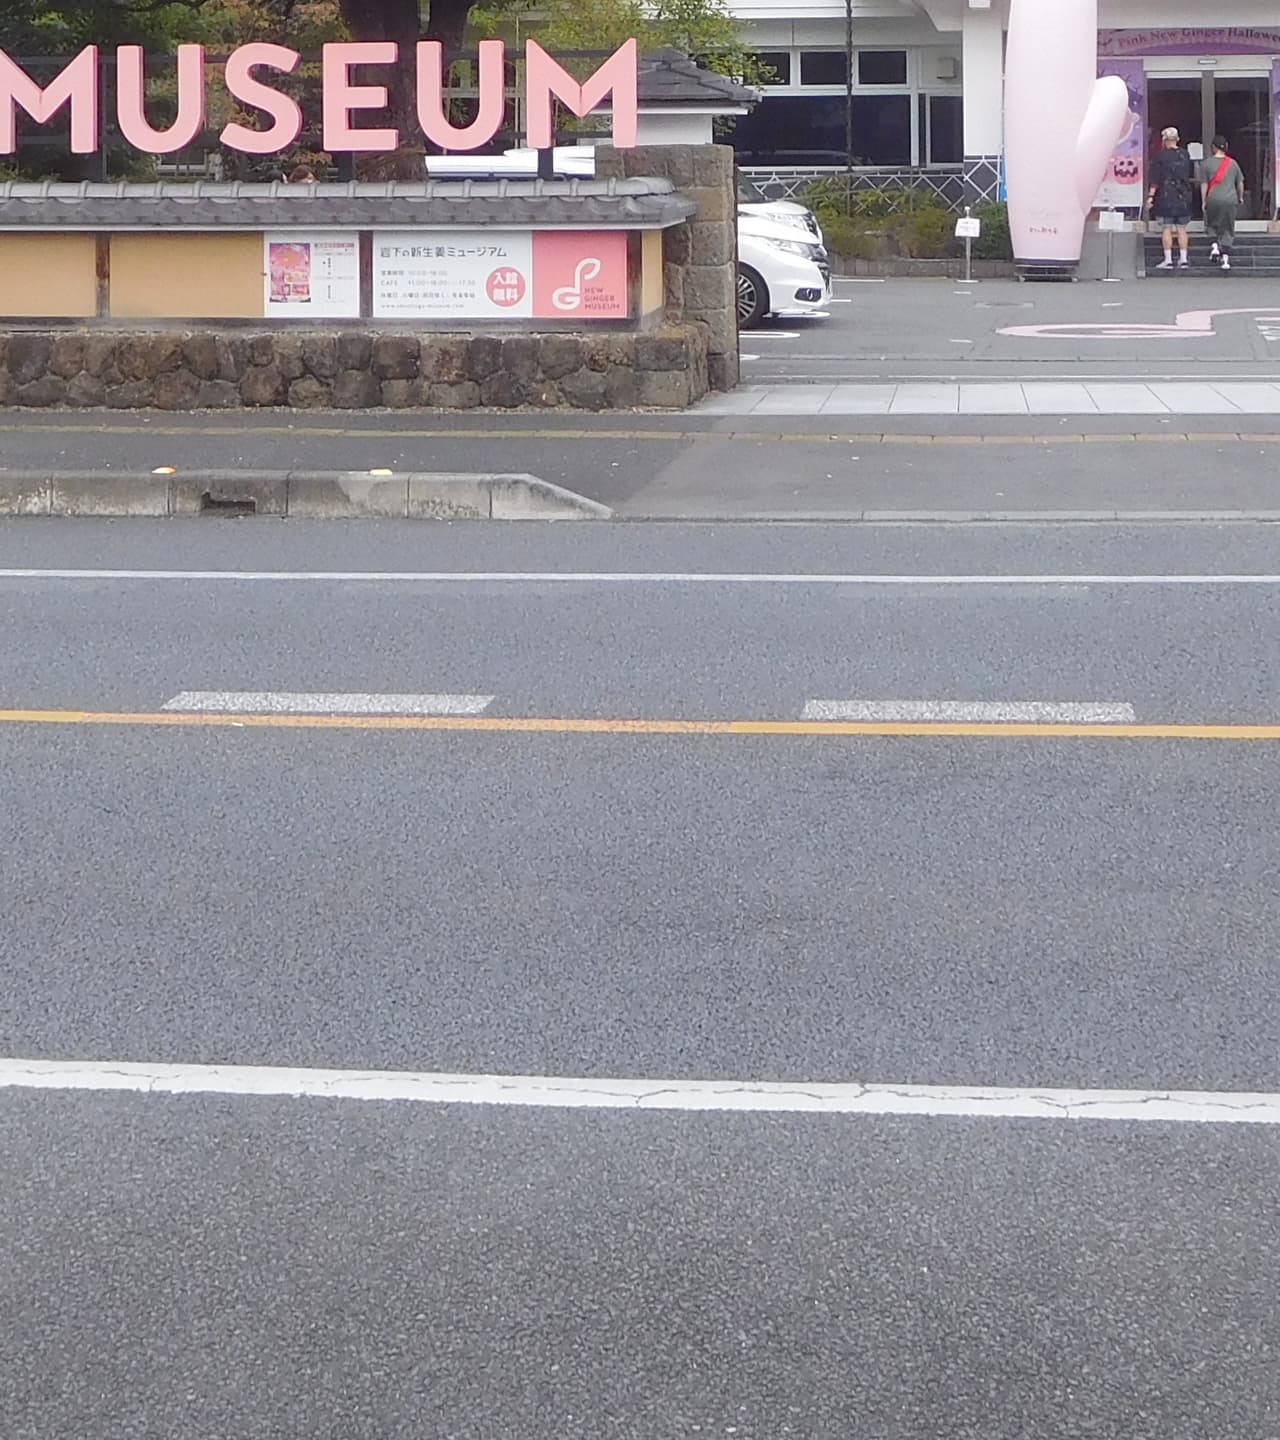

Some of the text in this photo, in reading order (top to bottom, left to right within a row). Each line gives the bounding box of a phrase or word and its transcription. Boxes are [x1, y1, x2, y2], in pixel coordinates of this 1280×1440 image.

[1118, 34, 1146, 47] Pink
[1150, 30, 1178, 41] New
[1182, 27, 1225, 38] Ginger
[584, 294, 615, 302] GINGER
